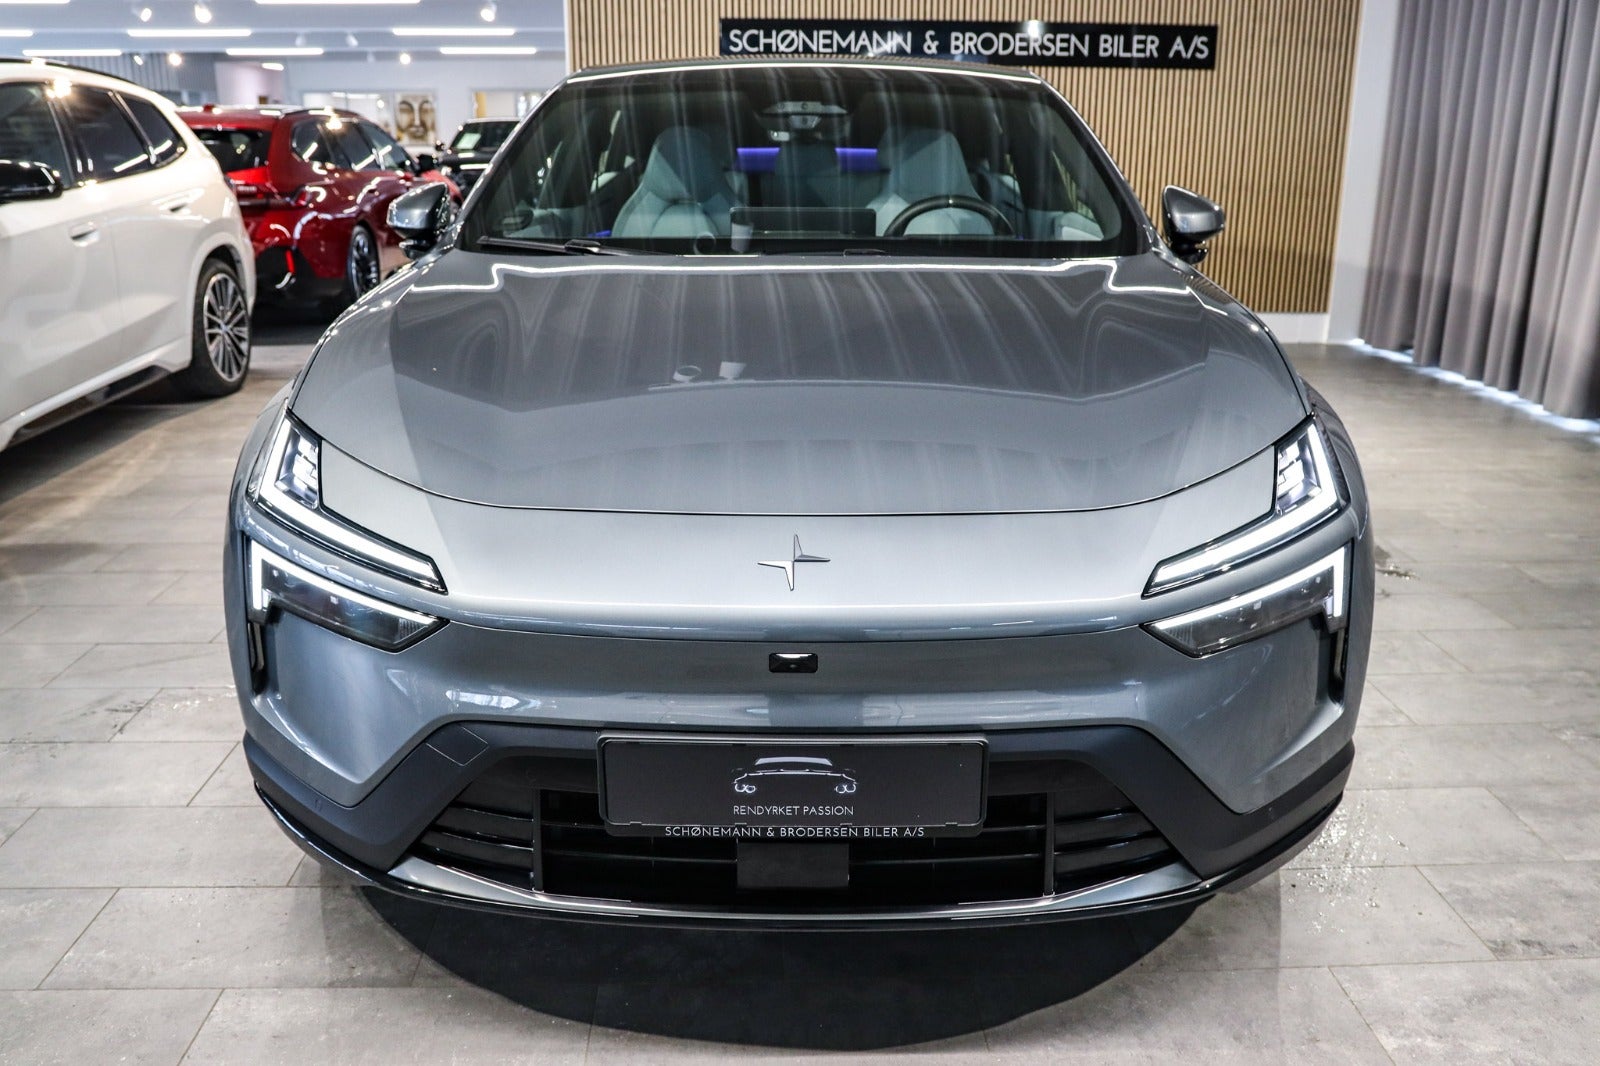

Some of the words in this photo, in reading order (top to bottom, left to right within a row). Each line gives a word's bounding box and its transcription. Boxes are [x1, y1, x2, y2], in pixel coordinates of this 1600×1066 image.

[728, 29, 912, 55] SCHØNEMANN
[923, 32, 939, 55] &
[950, 33, 1090, 57] BRODERSEN
[1099, 35, 1159, 58] BILER
[1169, 35, 1209, 59] A/S
[733, 805, 800, 816] RENDYRKET
[803, 805, 854, 816] PASSION
[665, 826, 761, 837] SCHØNEMANN
[766, 827, 775, 837] &
[780, 827, 857, 837] BRODERSEN
[863, 827, 899, 837] BILER
[903, 827, 925, 837] A/S
